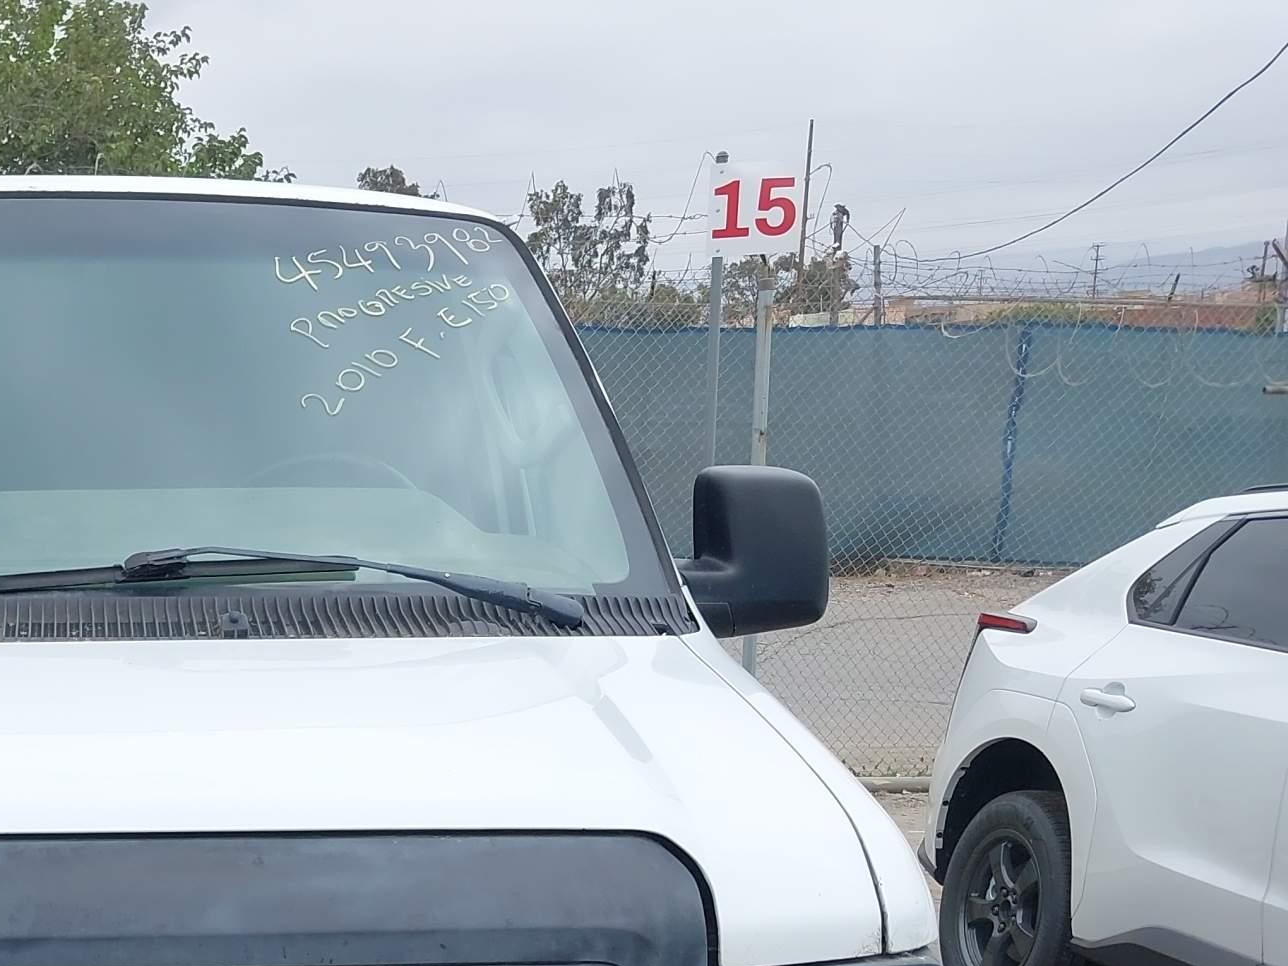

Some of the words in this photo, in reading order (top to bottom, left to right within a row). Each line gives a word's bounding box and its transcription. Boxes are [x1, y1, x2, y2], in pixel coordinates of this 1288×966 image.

[711, 177, 797, 239] 15
[273, 226, 503, 292] 45493982
[300, 349, 398, 416] 2010
